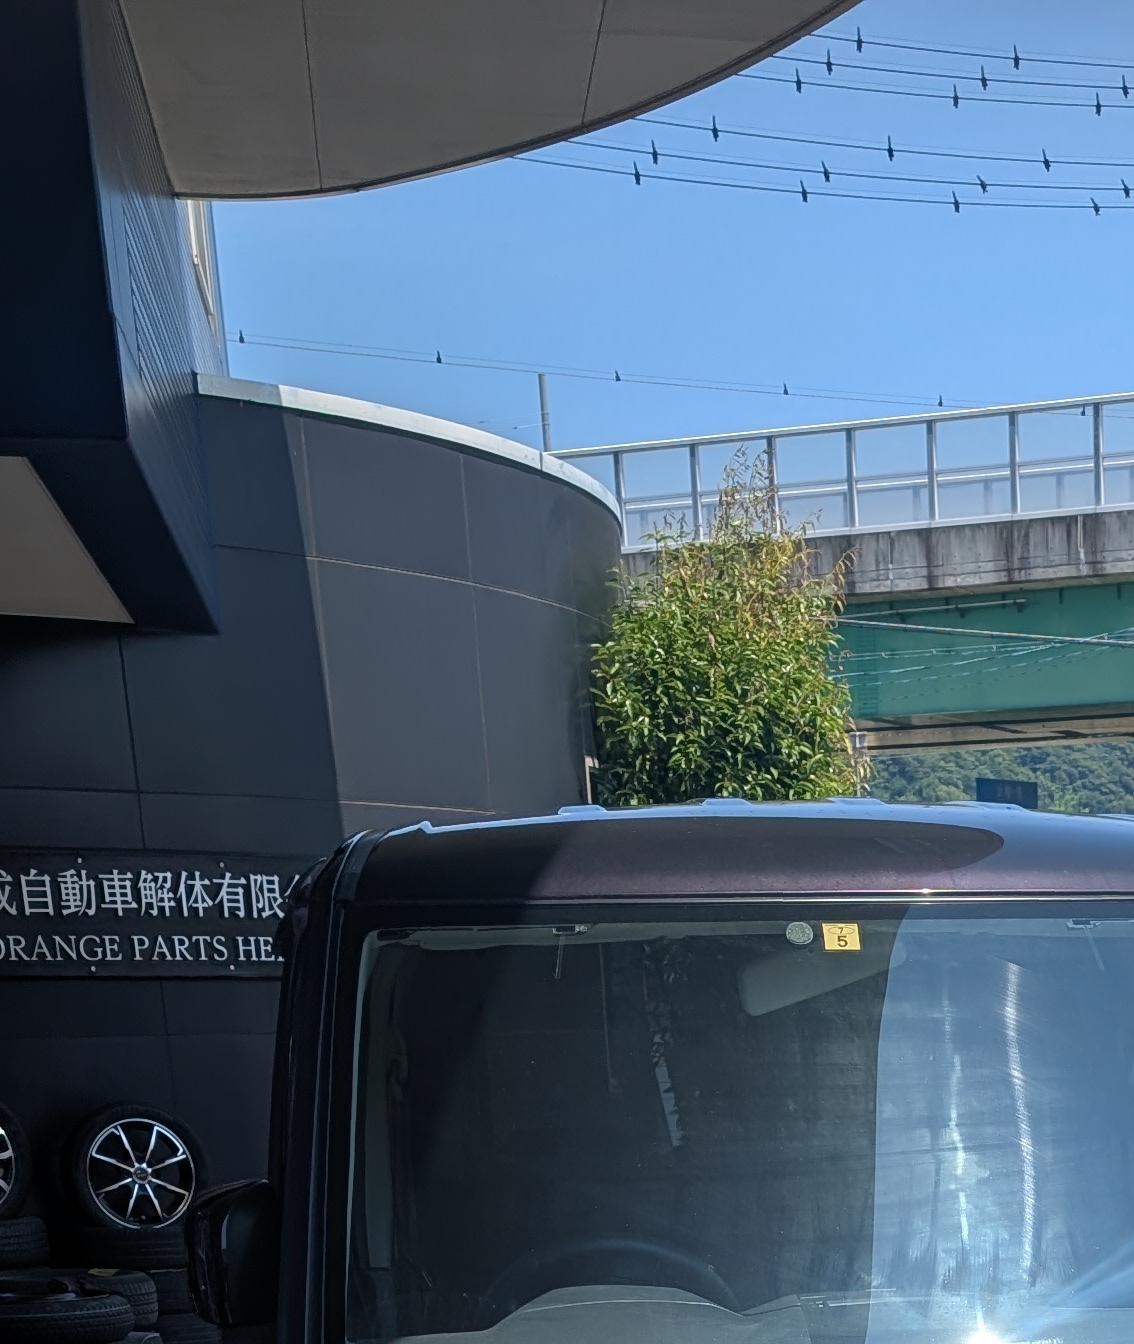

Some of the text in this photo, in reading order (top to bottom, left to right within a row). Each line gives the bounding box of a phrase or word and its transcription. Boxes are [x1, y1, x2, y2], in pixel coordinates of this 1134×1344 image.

[0, 868, 300, 919] 自動車解体有限
[0, 934, 285, 962] RANGE PARTS HE
[837, 935, 848, 948] 5
